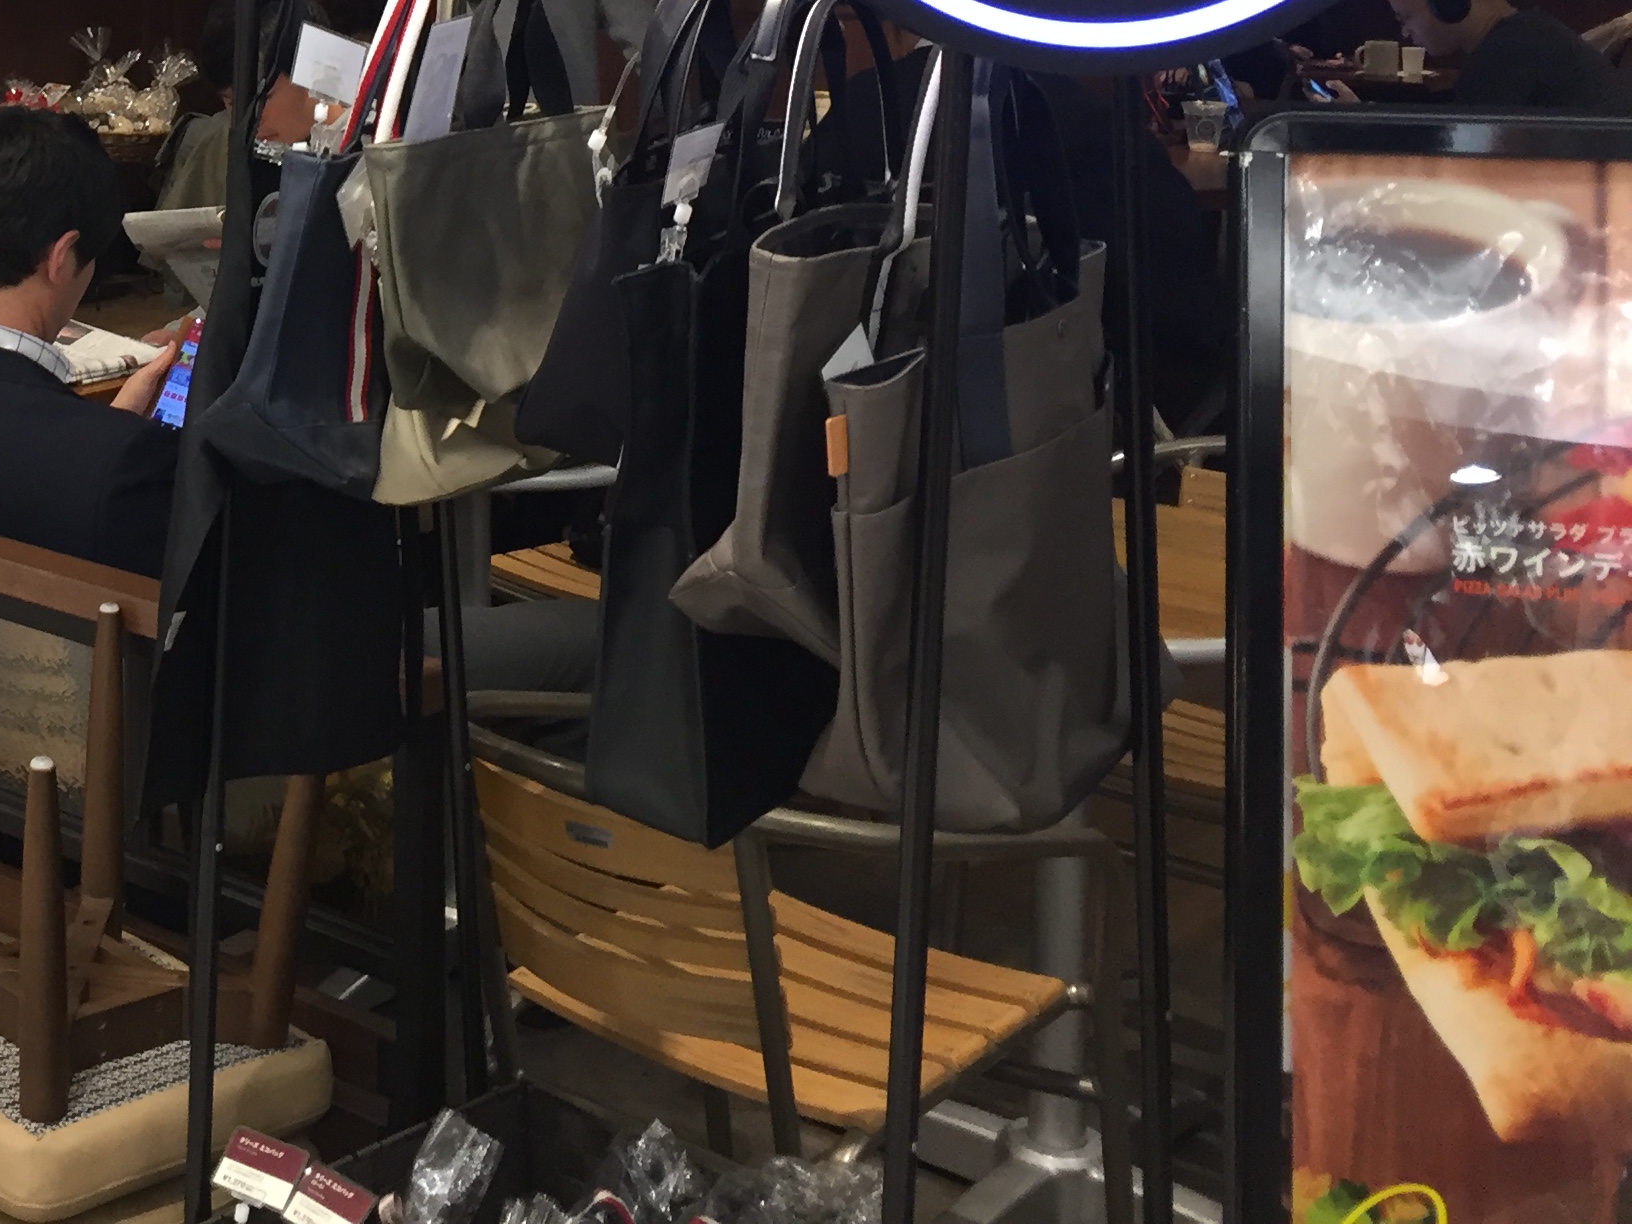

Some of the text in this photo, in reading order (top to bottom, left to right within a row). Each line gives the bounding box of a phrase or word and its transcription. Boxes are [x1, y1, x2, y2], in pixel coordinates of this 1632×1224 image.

[1452, 540, 1632, 582] 赤ワインデ
